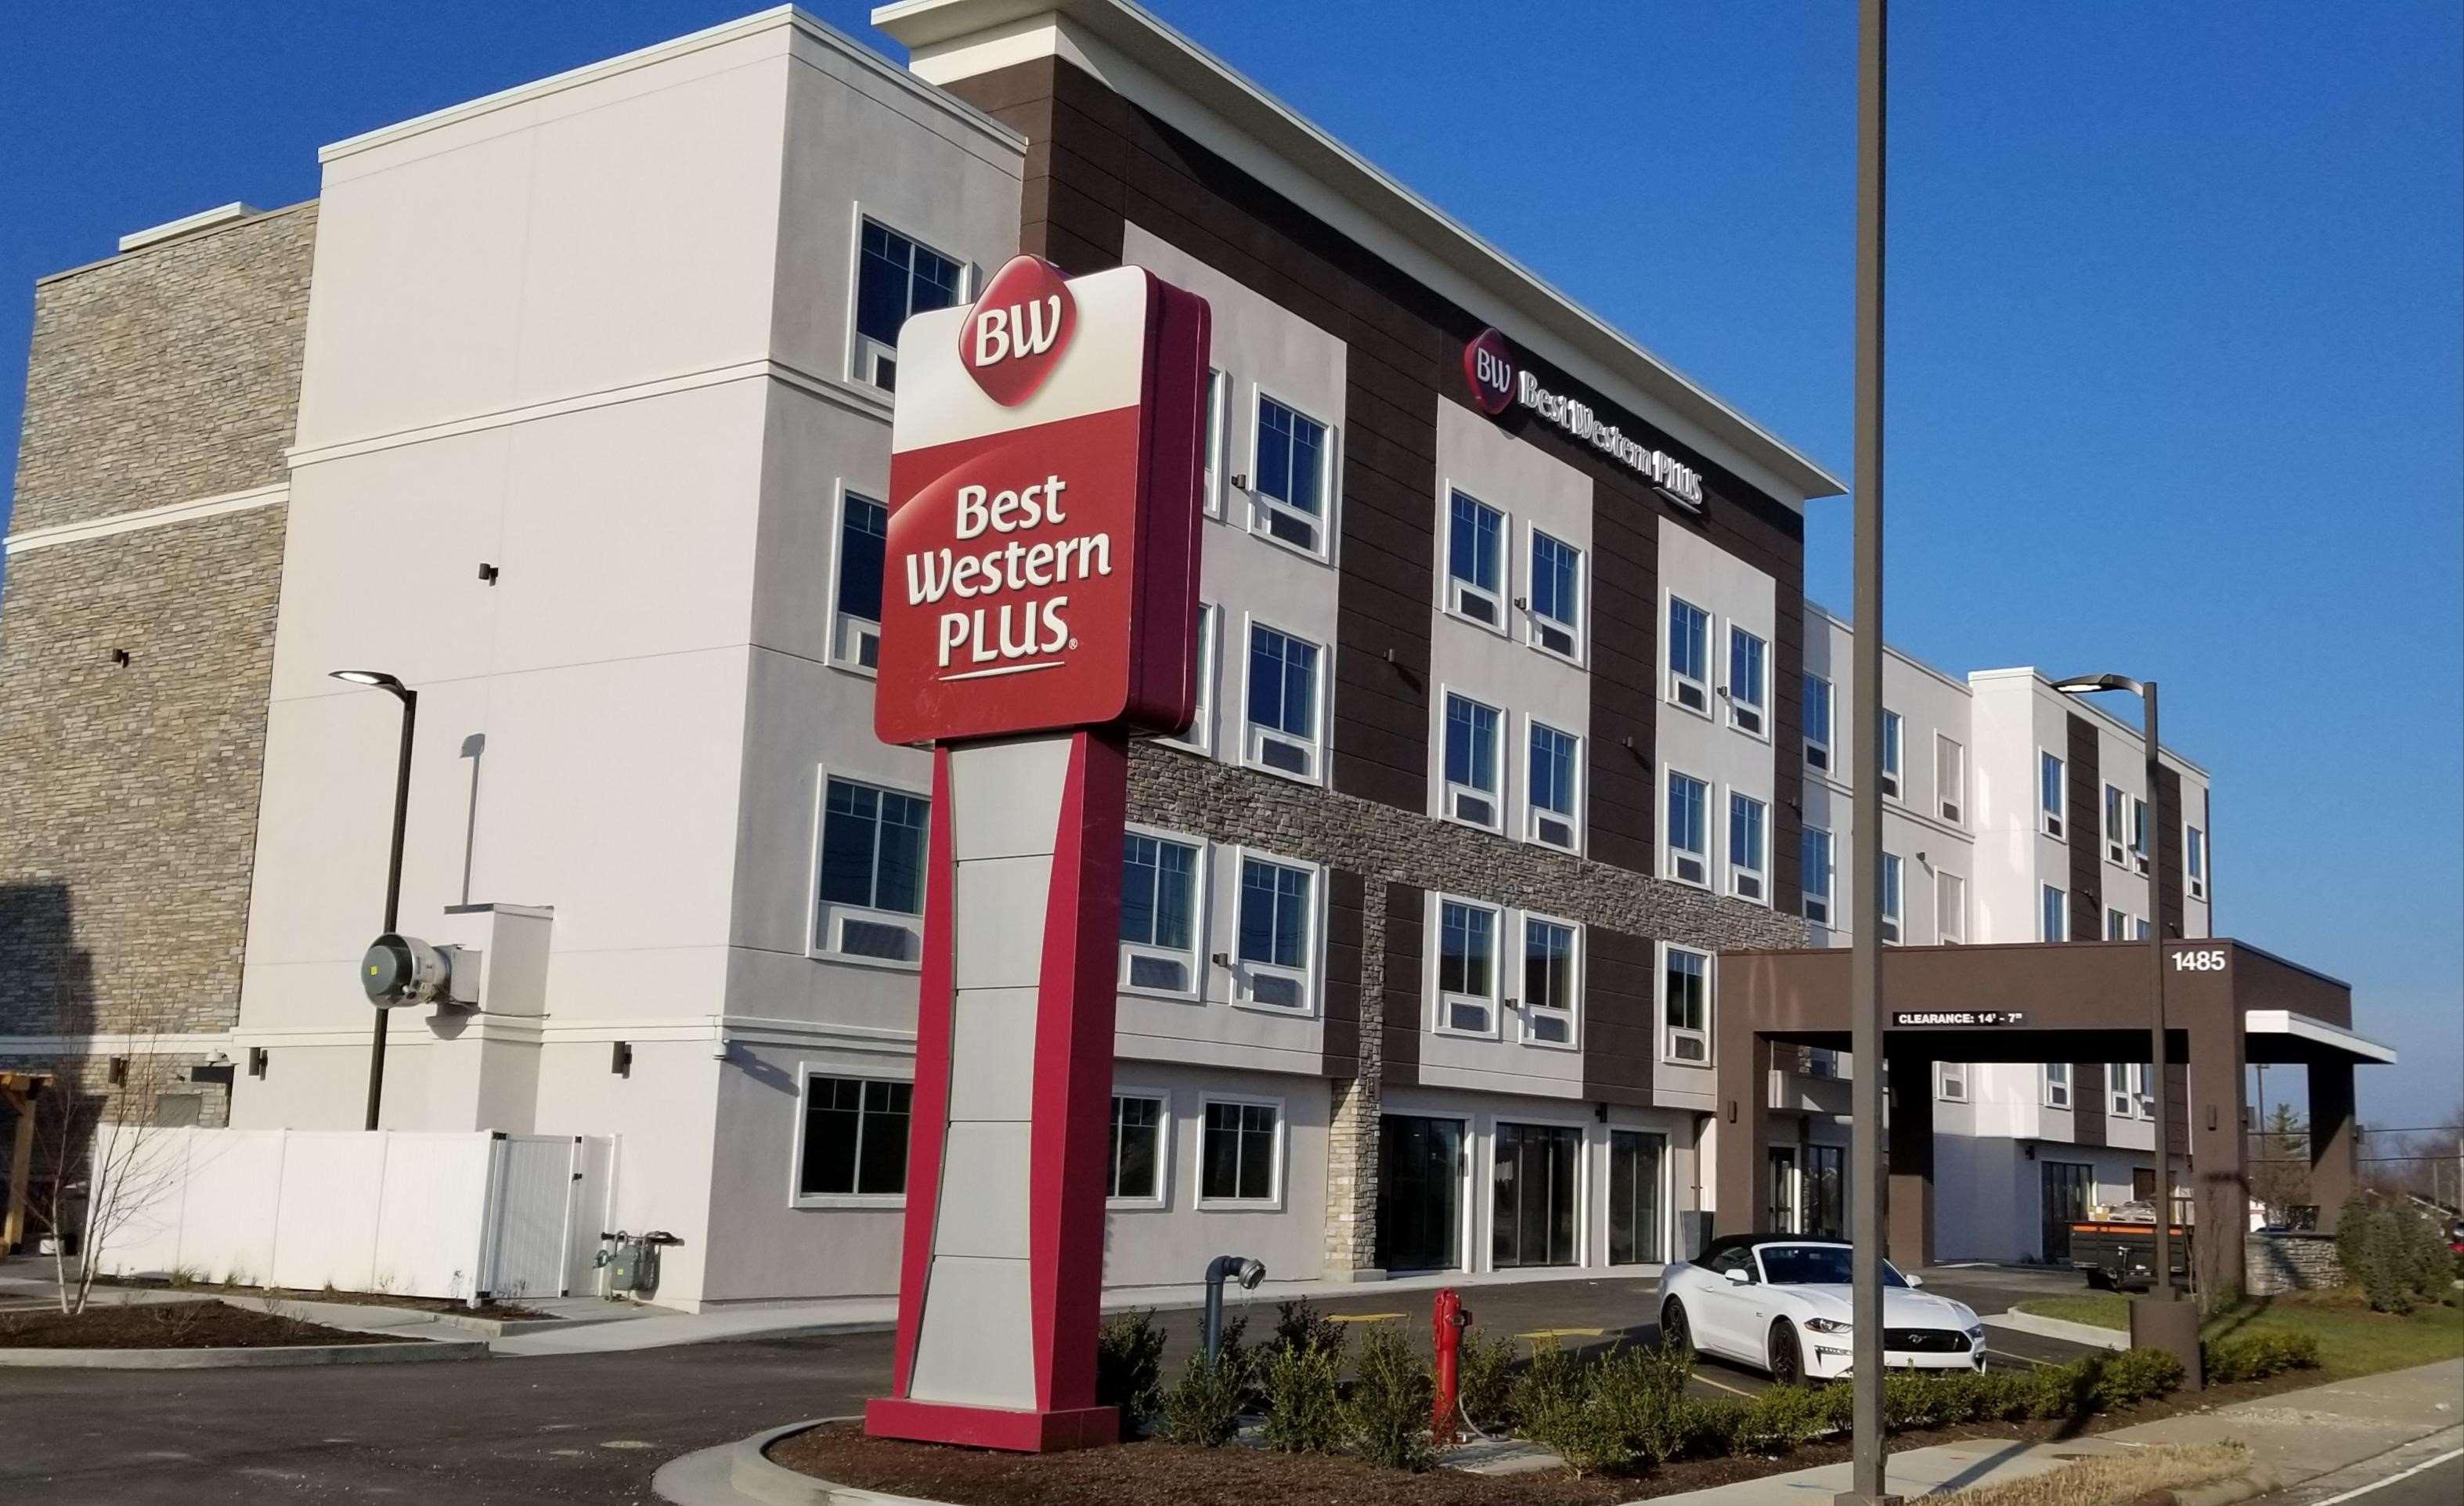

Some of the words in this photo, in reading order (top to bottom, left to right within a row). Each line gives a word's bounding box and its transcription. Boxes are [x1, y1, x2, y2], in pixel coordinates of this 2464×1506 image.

[975, 294, 1062, 368] BW
[1476, 347, 1511, 393] BW
[1517, 370, 1571, 429] Best
[1568, 399, 1652, 477] Western
[956, 475, 1066, 540] Best
[905, 533, 1113, 606] Western
[2171, 950, 2226, 971] 1485
[1899, 1013, 1975, 1024] CLEARANCE:
